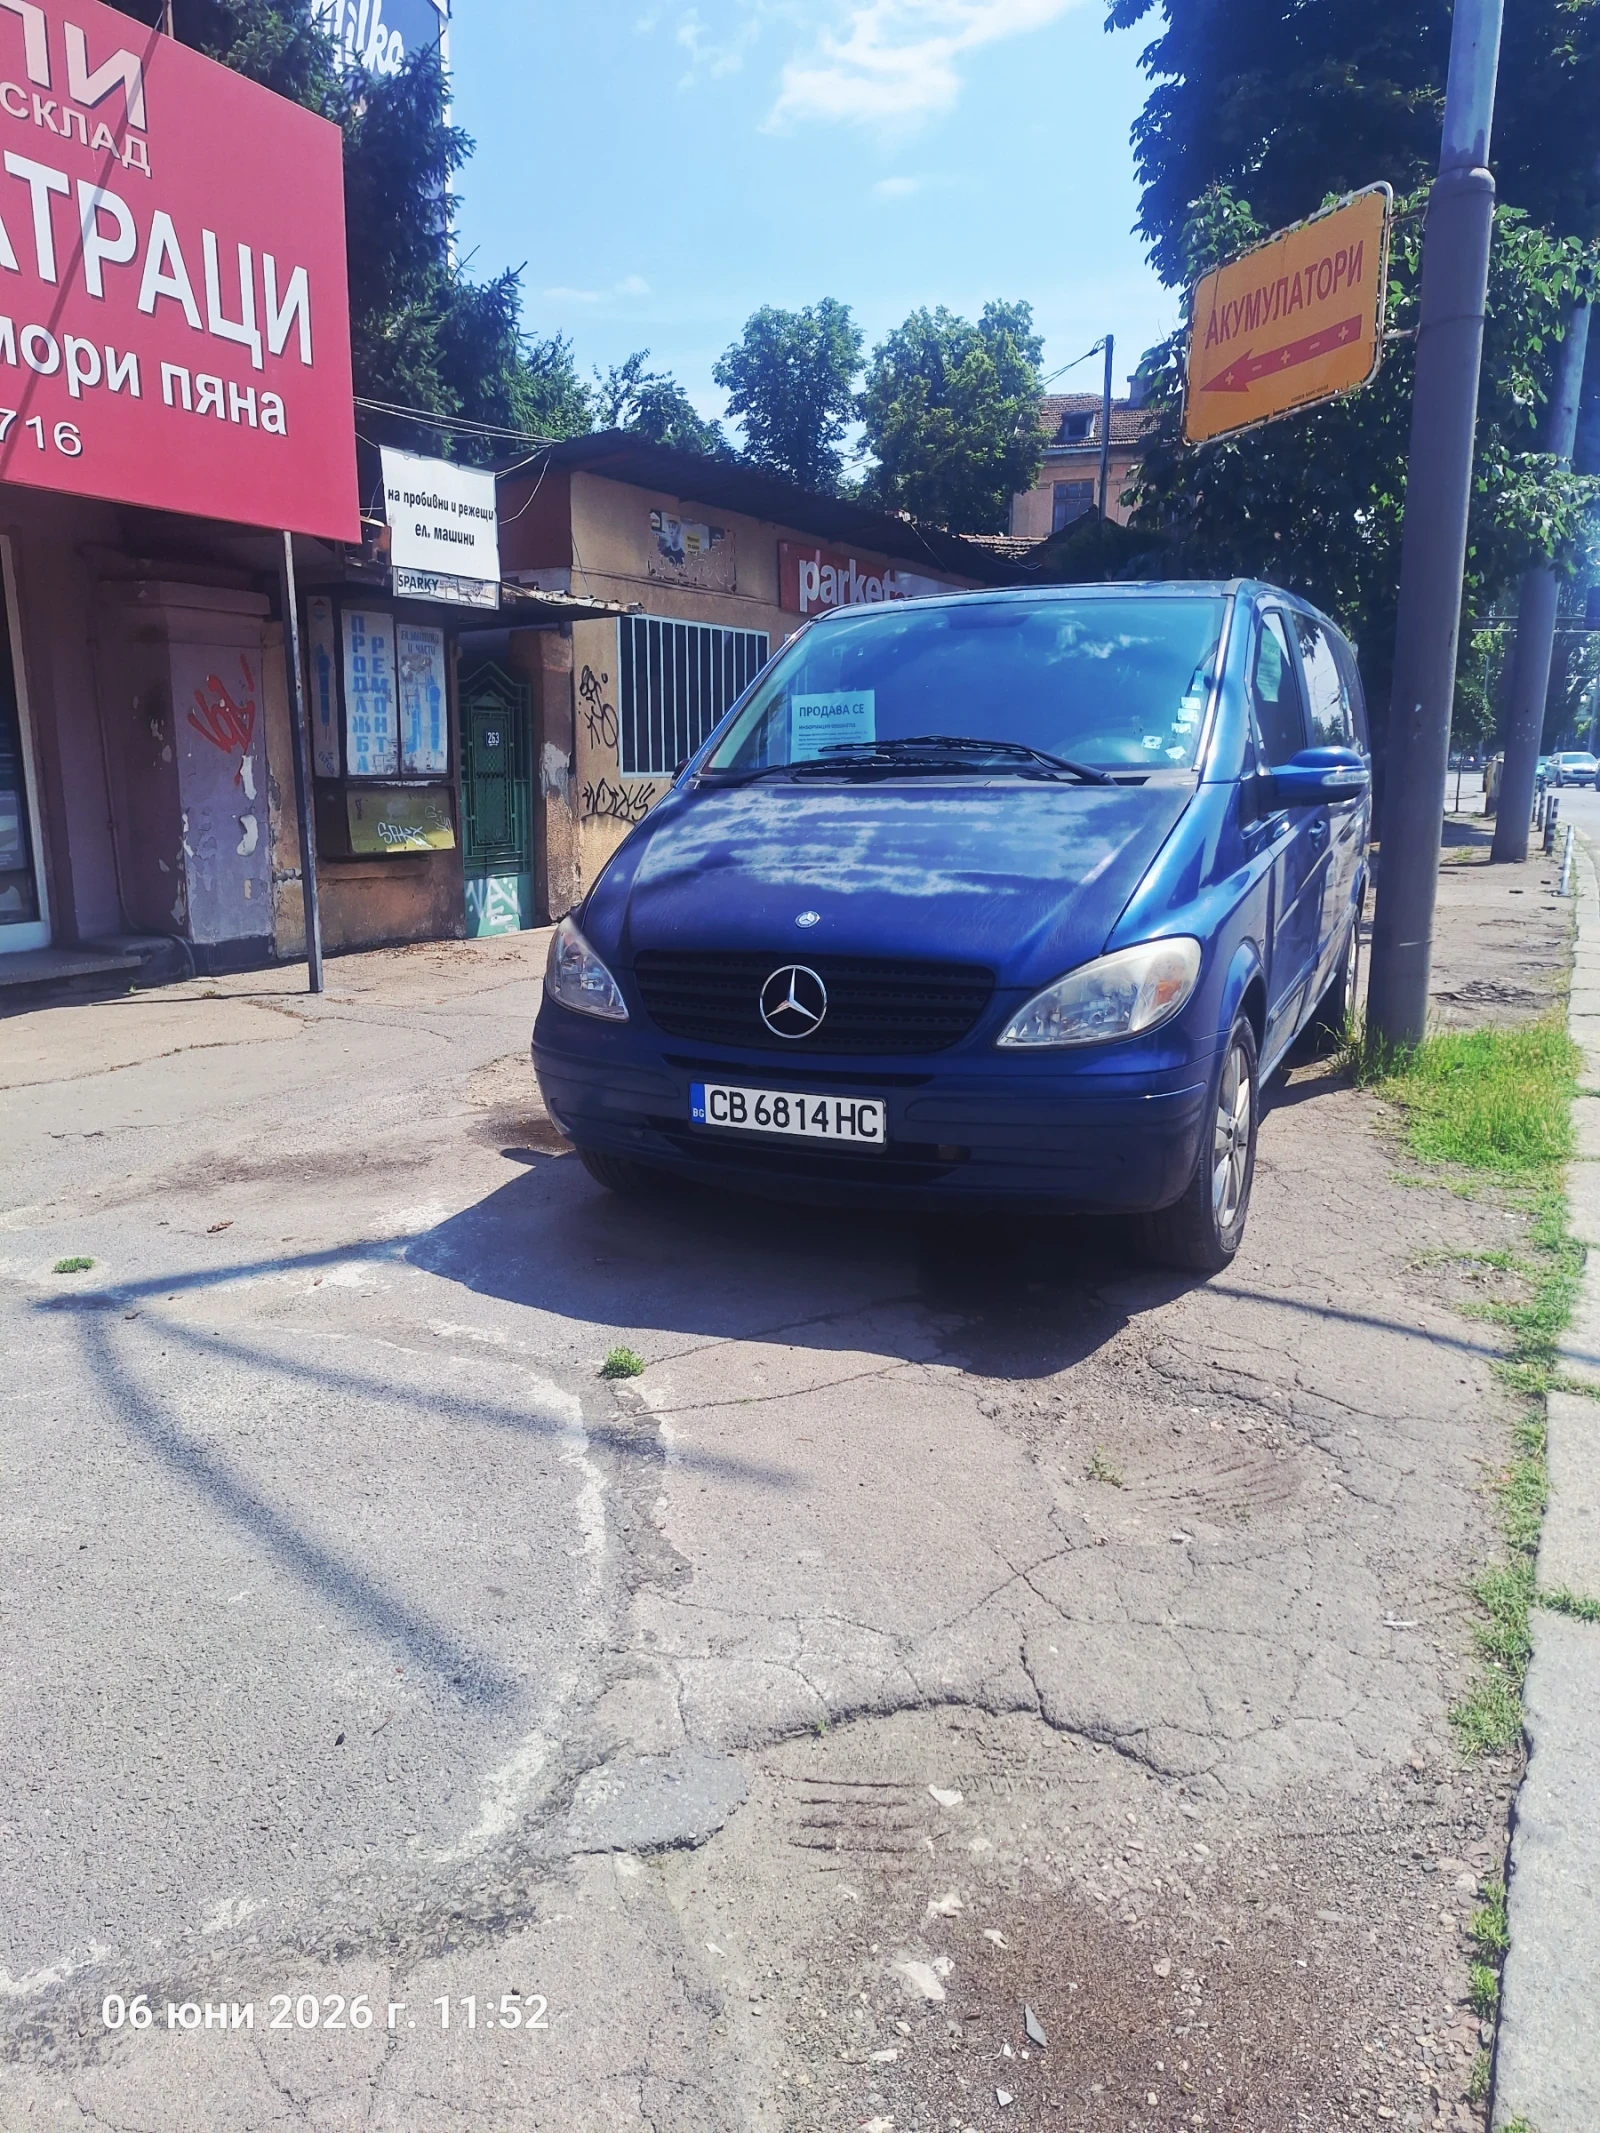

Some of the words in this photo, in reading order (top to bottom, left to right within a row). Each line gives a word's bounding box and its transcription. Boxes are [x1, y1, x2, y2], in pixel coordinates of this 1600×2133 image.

[0, 82, 152, 178] СКЛАД
[0, 150, 313, 366] ТРАЦИ
[1205, 240, 1364, 349] АКУМУЛАТОРИ
[161, 361, 287, 435] пяна
[388, 488, 400, 502] на
[403, 491, 449, 511] пробивни
[451, 502, 456, 513] и
[458, 502, 494, 526] режещи
[415, 523, 430, 538] ел.
[434, 527, 475, 547] машини
[398, 574, 439, 591] SPARKY
[371, 636, 389, 753] РЕМОНТ
[799, 705, 850, 718] ПРОДАВА
[852, 703, 865, 714] СЕ
[487, 732, 500, 744] 263
[692, 1107, 705, 1118] BG
